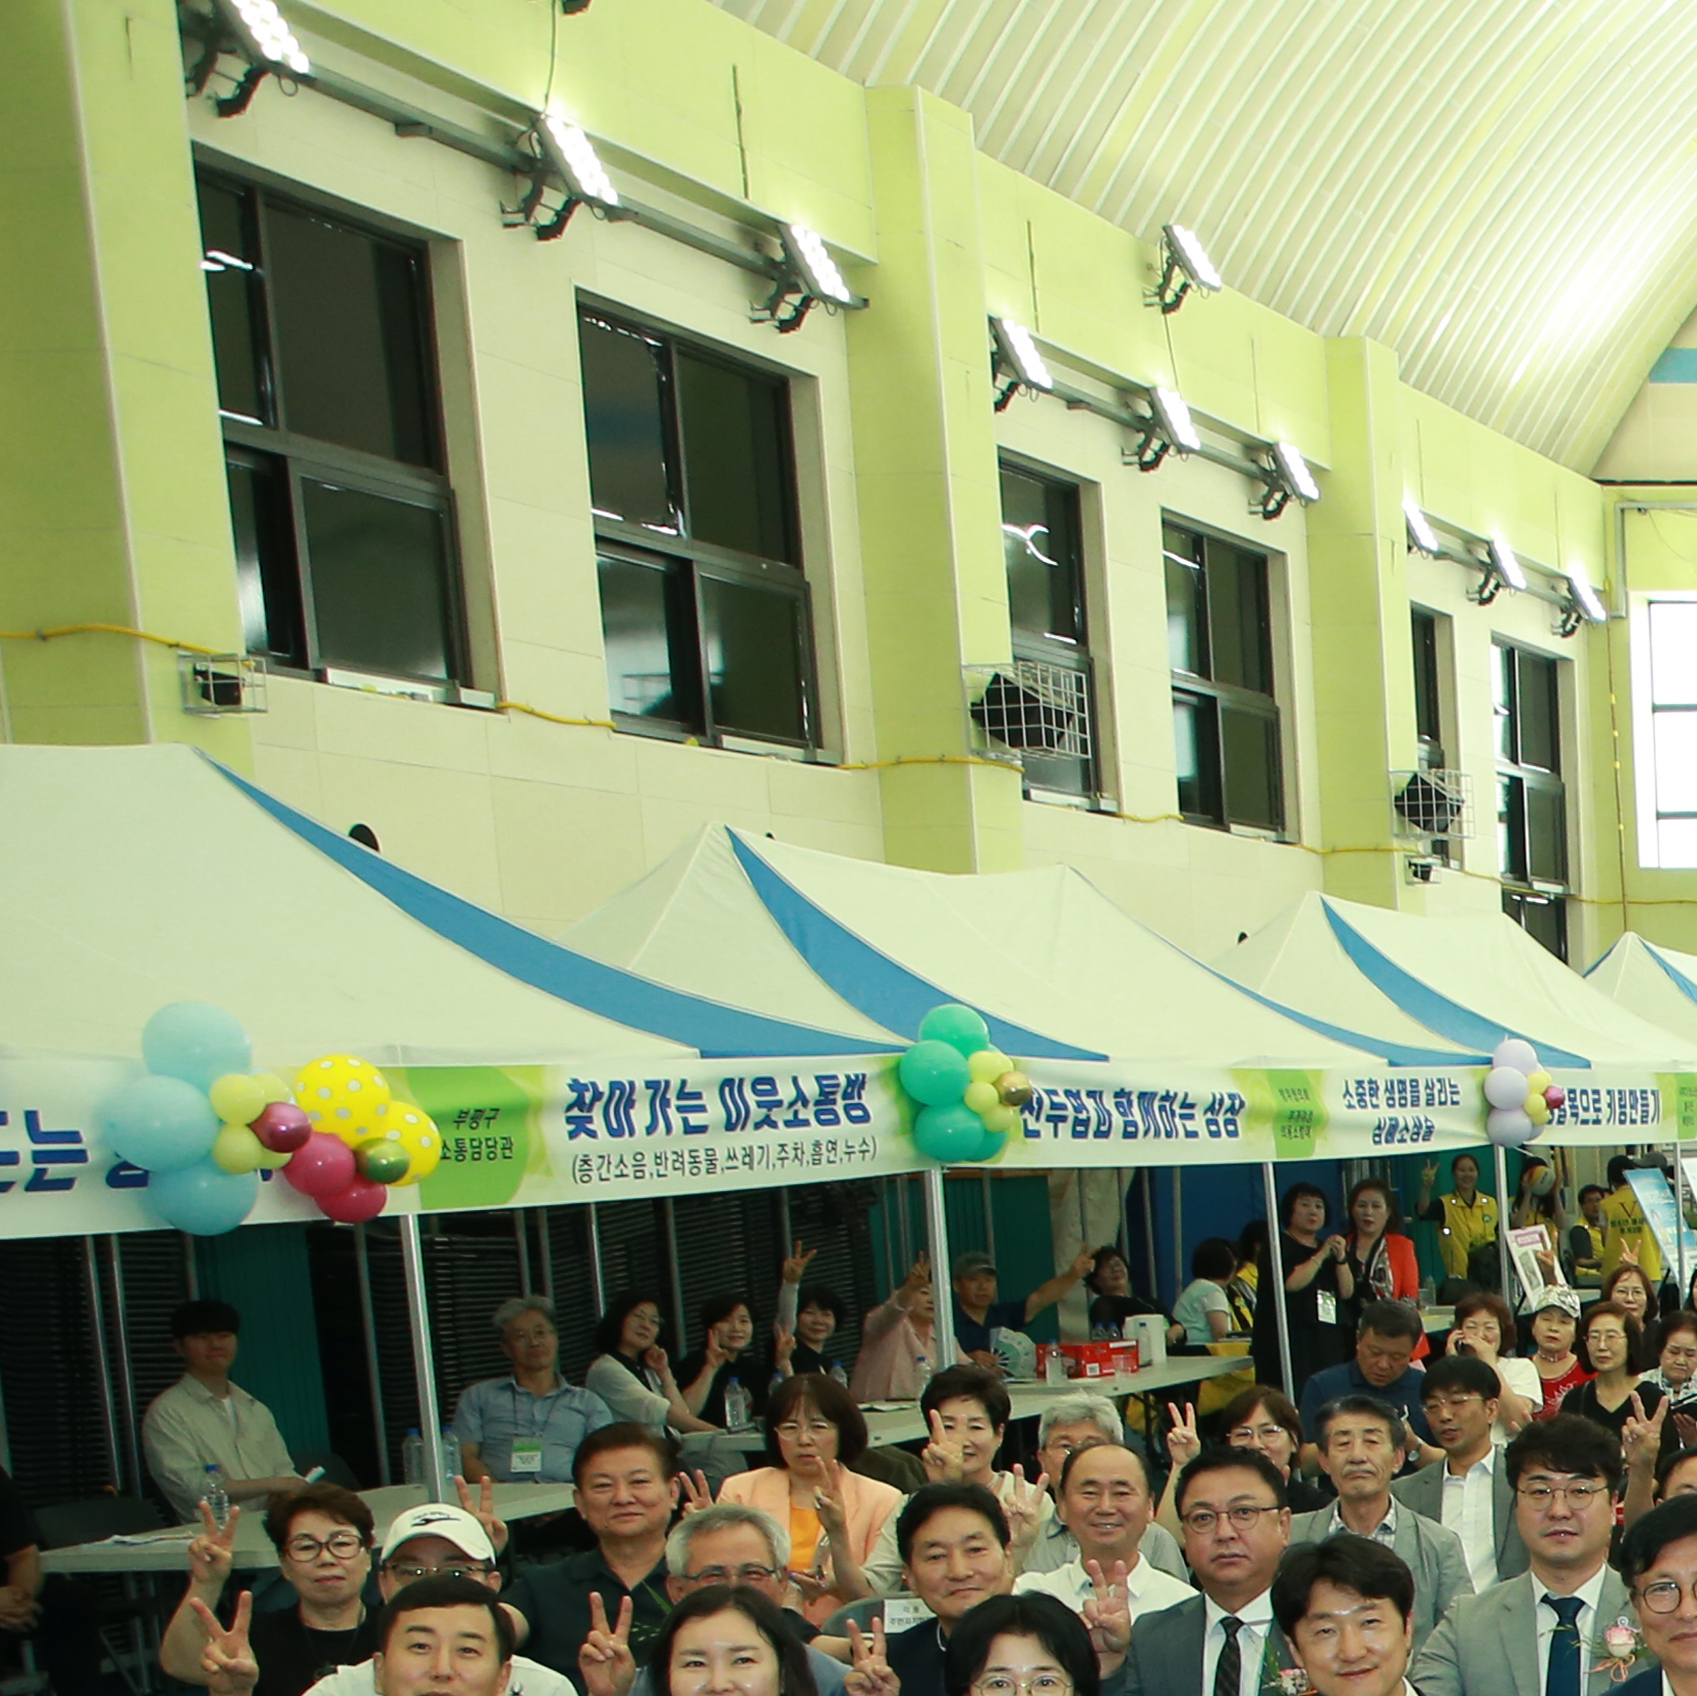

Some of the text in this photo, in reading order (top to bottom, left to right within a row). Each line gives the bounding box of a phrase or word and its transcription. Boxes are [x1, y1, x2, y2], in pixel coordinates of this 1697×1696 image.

[565, 1072, 872, 1142] 찾아가는 이웃소통방
[1342, 1077, 1381, 1110] 소중한
[1384, 1077, 1421, 1109] 생명을
[1424, 1076, 1461, 1107] 살리는
[452, 1108, 500, 1129] 부평구
[1114, 1087, 1201, 1140] 함께하는
[1203, 1091, 1247, 1139] 성장
[1371, 1115, 1436, 1146] 심폐소생술
[439, 1137, 514, 1164] 소통담당관
[571, 1135, 878, 1185] (층간소음,반려동물,쓰레기,주차,흡연,누수)
